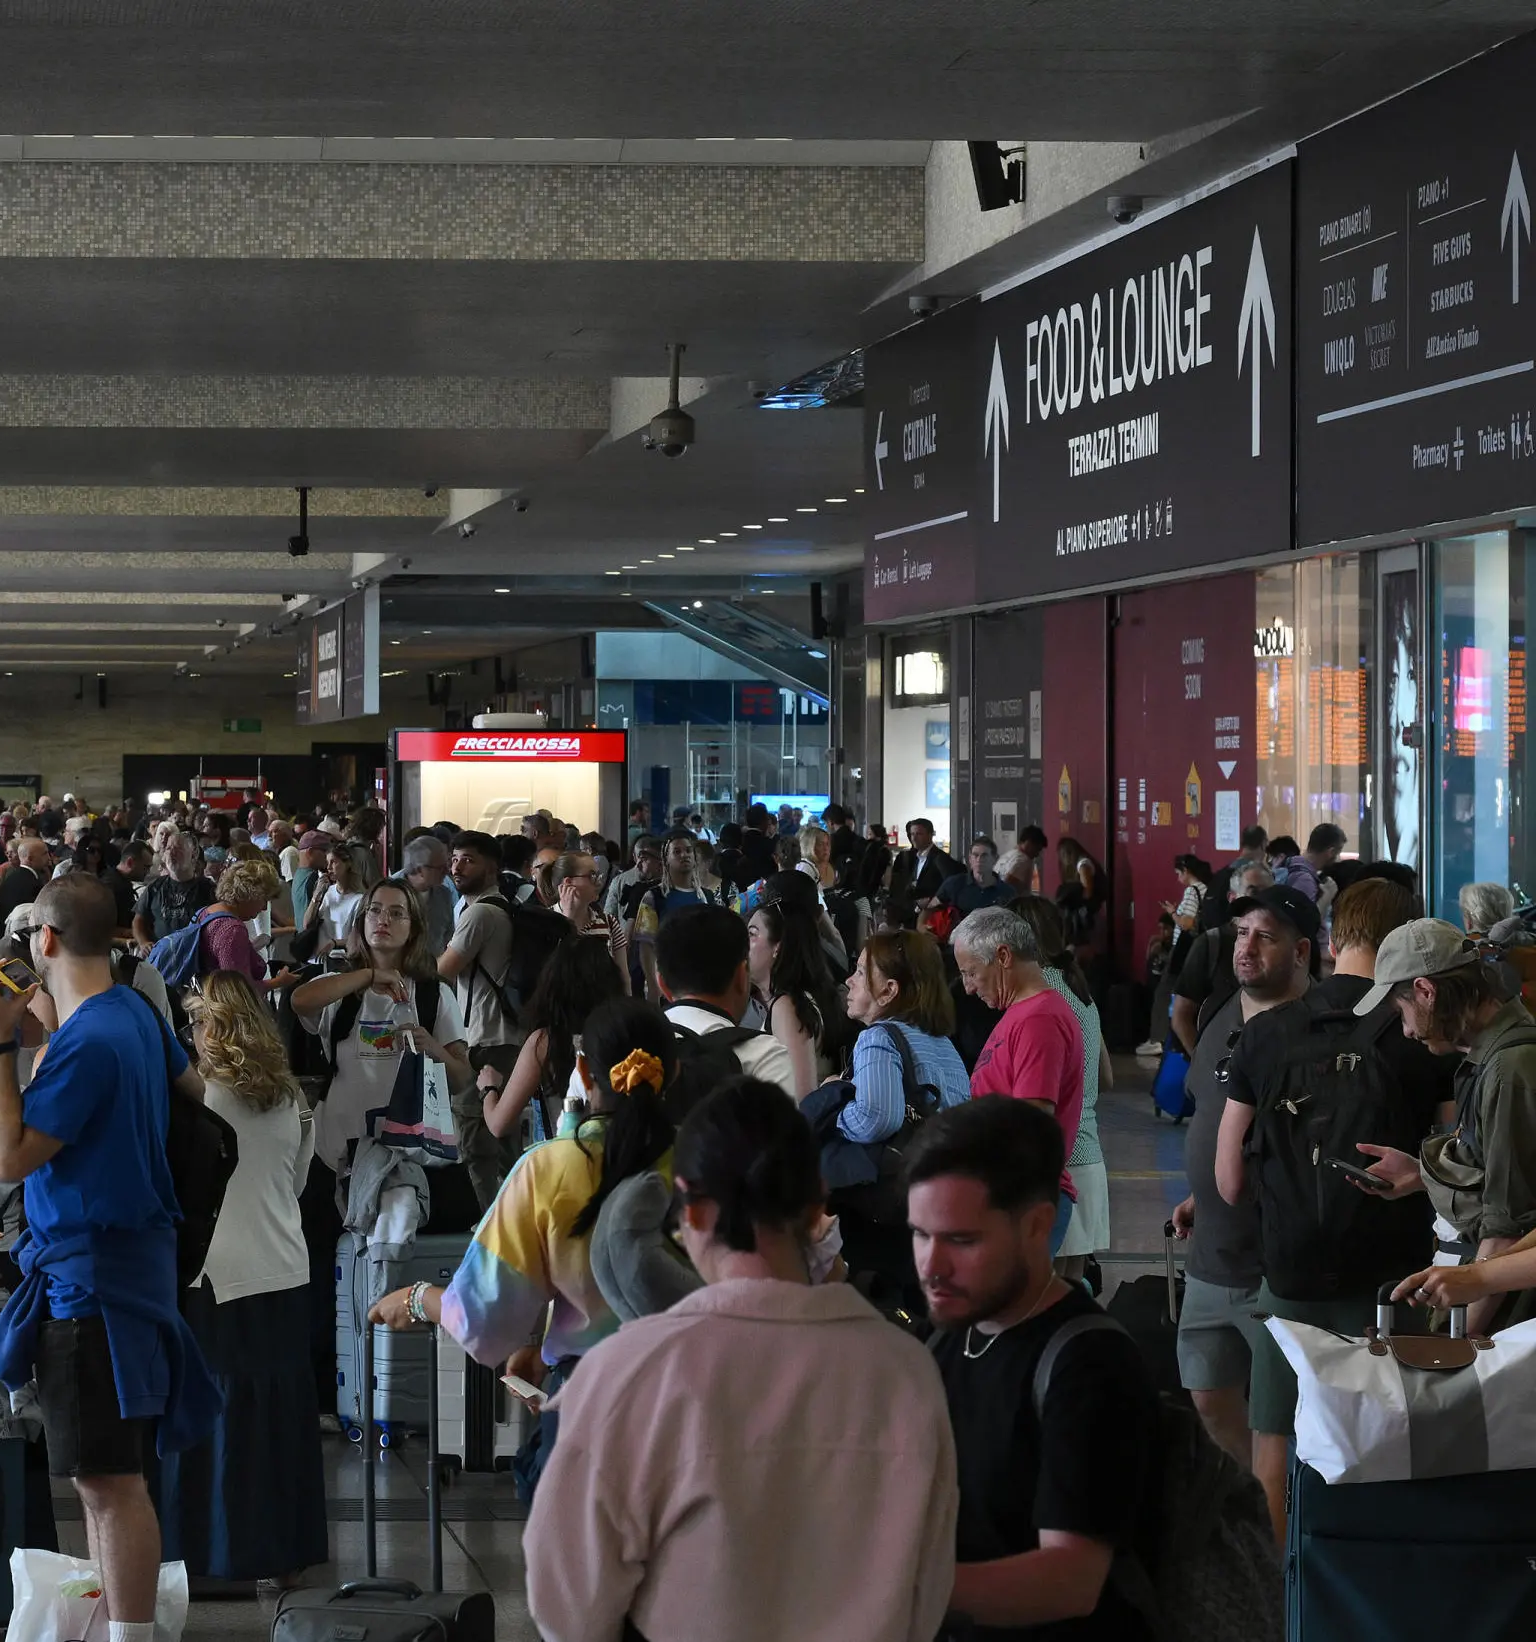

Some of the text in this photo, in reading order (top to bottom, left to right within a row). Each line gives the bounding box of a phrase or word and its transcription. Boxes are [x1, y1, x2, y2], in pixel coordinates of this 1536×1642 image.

[1419, 180, 1440, 209] PIANO
[1319, 221, 1339, 247] PIANO
[1339, 209, 1362, 240] BINARI
[1433, 232, 1471, 266] FIVE GUYS
[1323, 276, 1356, 317] DOUGLAS
[1430, 279, 1474, 313] STARBUCKS
[1026, 245, 1212, 424] FOOD & LOUNGE
[1324, 335, 1355, 376] UNIQLO
[903, 413, 937, 462] CENTRALE
[1068, 412, 1159, 477] TERRAZZA TERMINI
[1413, 425, 1506, 469] Pharmacy Toilets
[1056, 528, 1066, 556] AL
[1066, 524, 1087, 554] PIANO
[1088, 514, 1128, 550] SUPERIORE
[1185, 674, 1201, 700] SOON
[454, 737, 580, 750] FRECCIAROSSA
